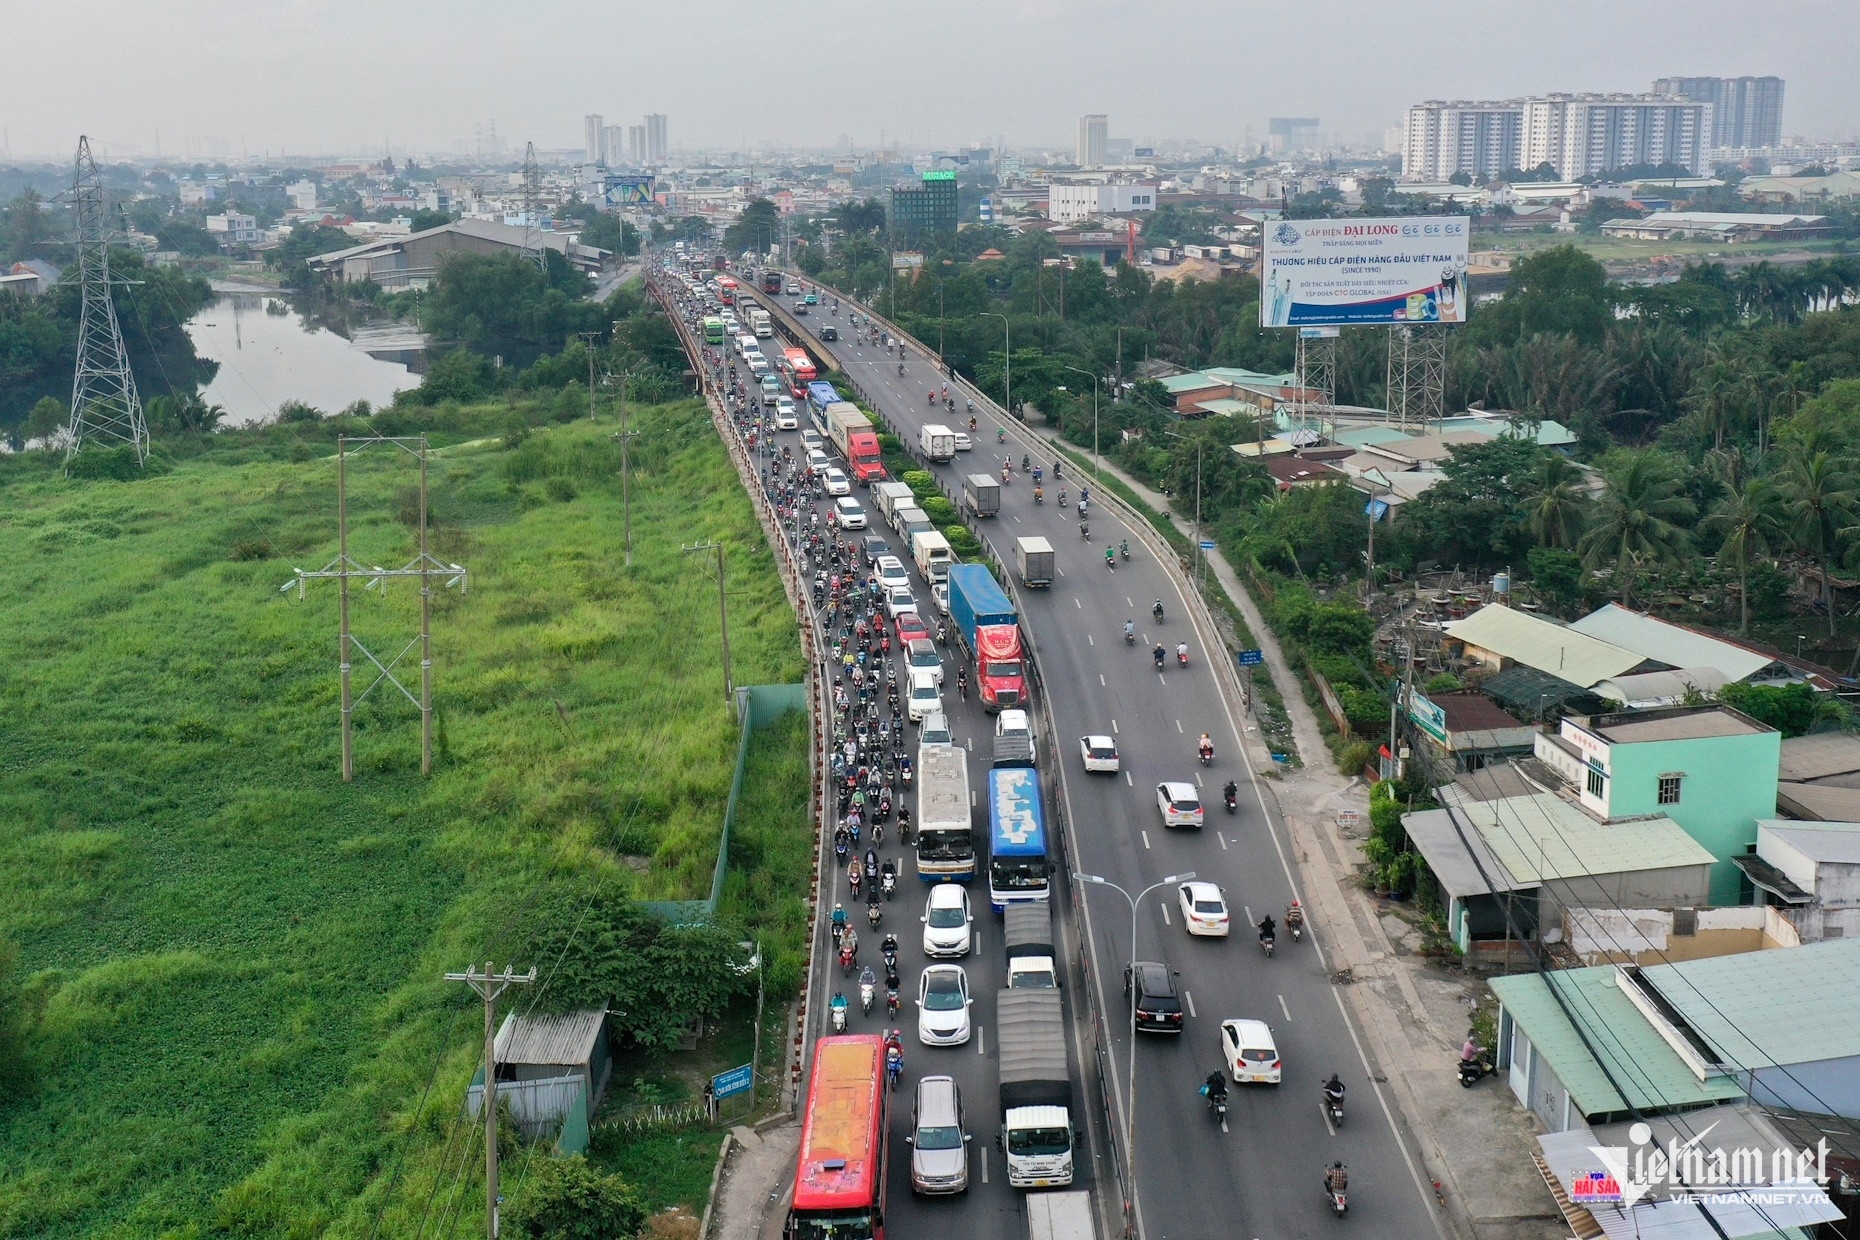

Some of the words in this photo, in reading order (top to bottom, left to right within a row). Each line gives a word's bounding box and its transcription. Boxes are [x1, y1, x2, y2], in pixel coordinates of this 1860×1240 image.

[1305, 228, 1320, 236] CÁP
[1322, 228, 1342, 237] ĐIỆN
[1344, 226, 1364, 238] ĐẠI
[1366, 224, 1398, 235] LONG
[1272, 258, 1306, 266] THƯƠNG
[1307, 256, 1326, 266] HIỆU
[1329, 256, 1345, 265] CÁP
[1347, 255, 1366, 265] ĐIỆN
[1369, 255, 1392, 264] HÀNG
[1394, 253, 1410, 263] ĐẦU
[1413, 254, 1430, 264] VIỆT
[1575, 1176, 1593, 1194] HẢI
[1597, 1175, 1620, 1194] SẢN
